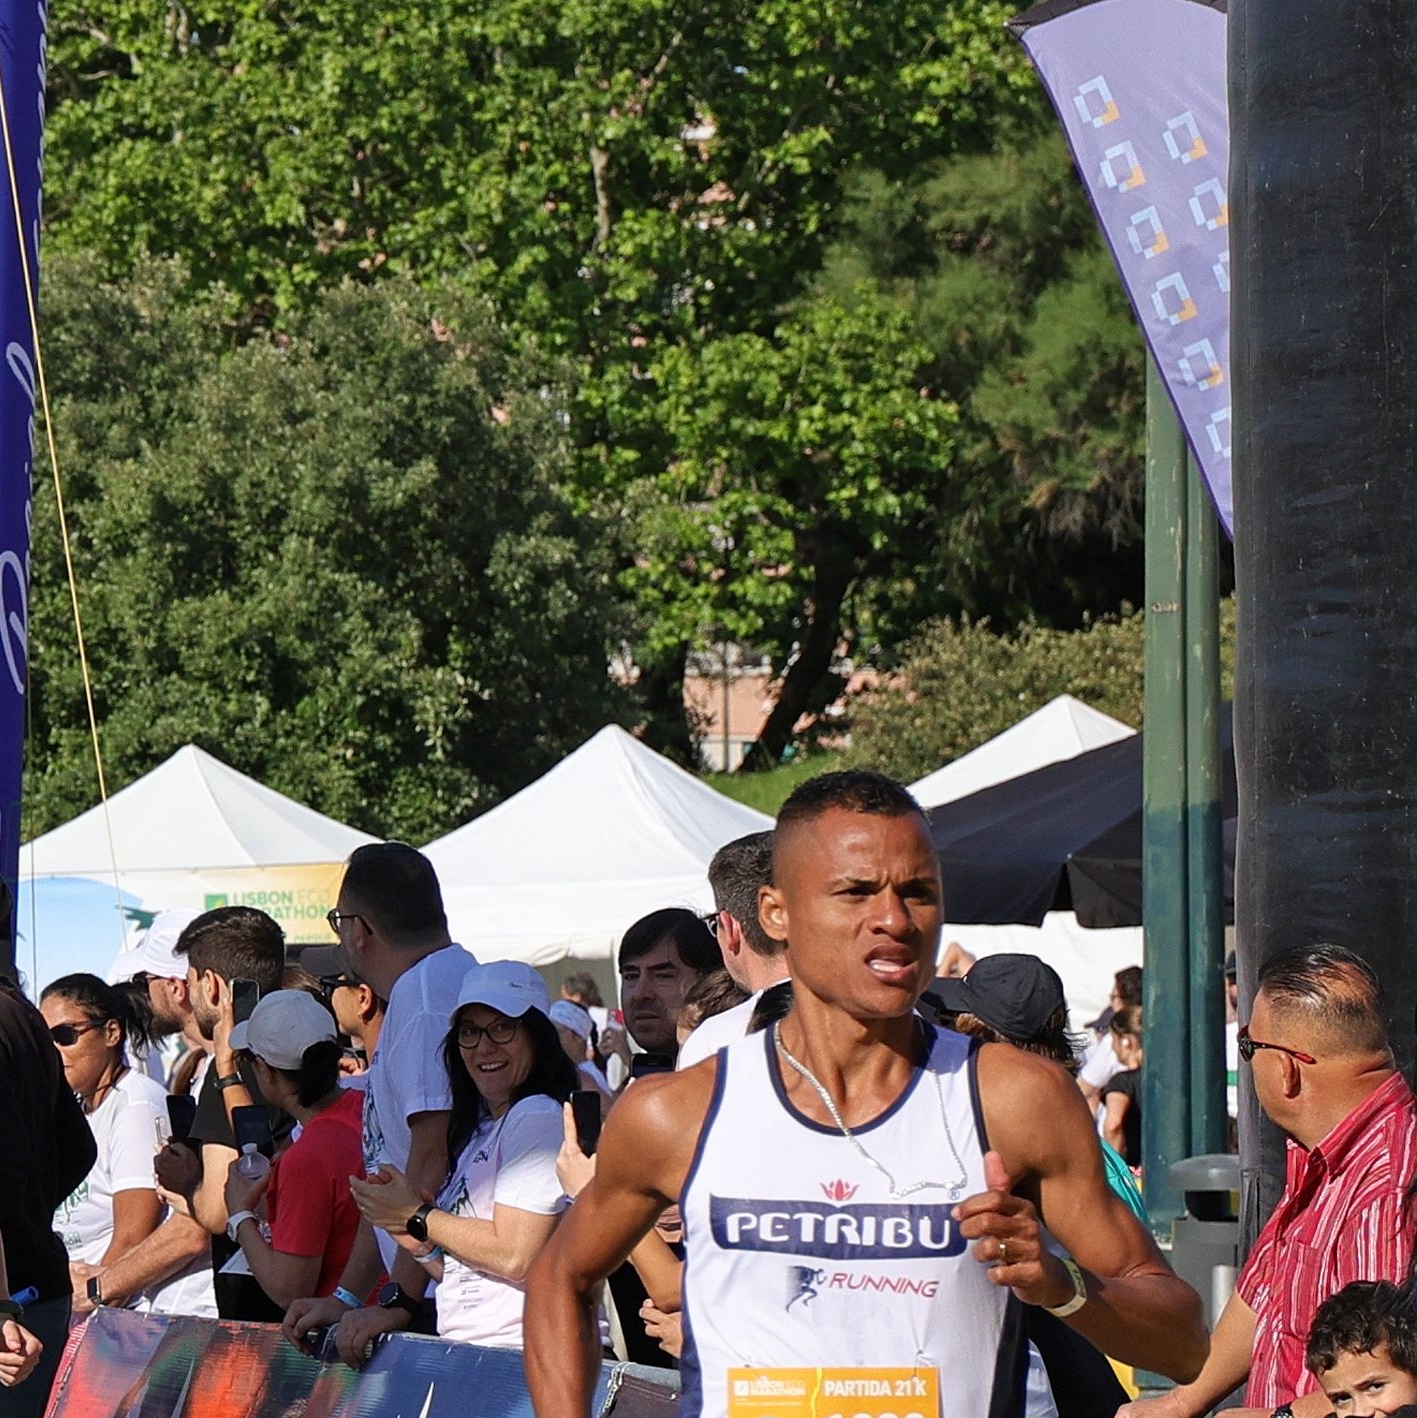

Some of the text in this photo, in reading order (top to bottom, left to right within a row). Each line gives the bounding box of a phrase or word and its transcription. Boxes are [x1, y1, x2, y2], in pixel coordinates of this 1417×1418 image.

[232, 890, 294, 906] LISBON
[263, 904, 331, 920] RATHON
[725, 1211, 952, 1251] PETRIBU
[828, 1271, 940, 1299] RUNNING
[824, 1380, 892, 1397] PARTIDA
